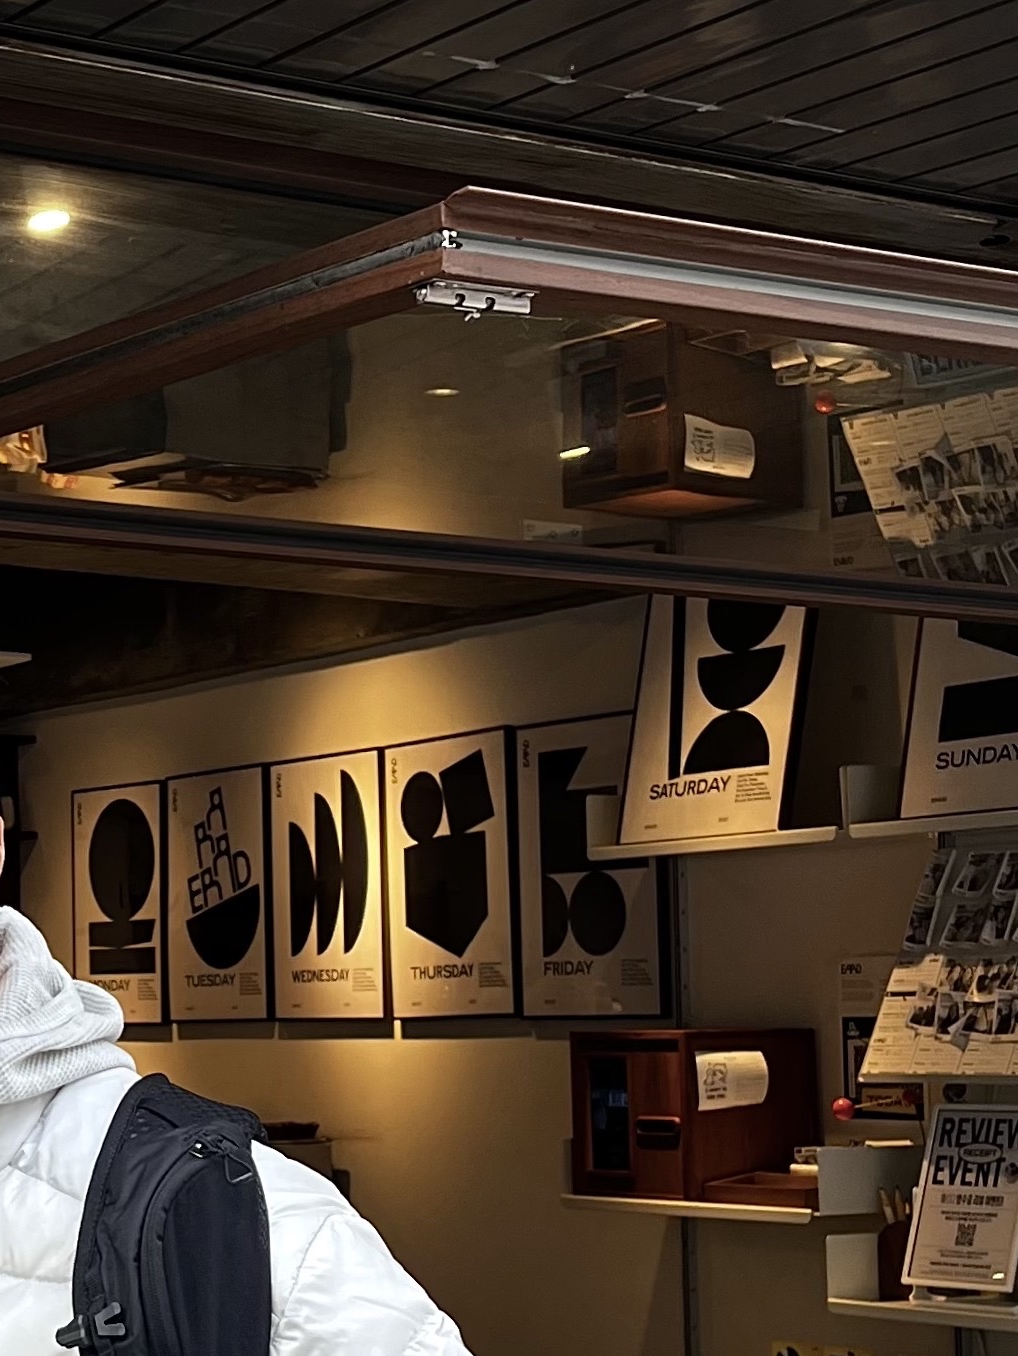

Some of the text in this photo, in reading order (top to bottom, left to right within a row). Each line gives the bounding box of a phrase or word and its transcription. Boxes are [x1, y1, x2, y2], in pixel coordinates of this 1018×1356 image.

[649, 775, 732, 801] SATURDAY
[291, 968, 350, 983] WEDNESDAY
[410, 963, 474, 980] THURSDAY
[543, 960, 594, 977] FRIDAY
[185, 973, 236, 987] TUESDAY
[932, 1155, 1006, 1188] EVENT
